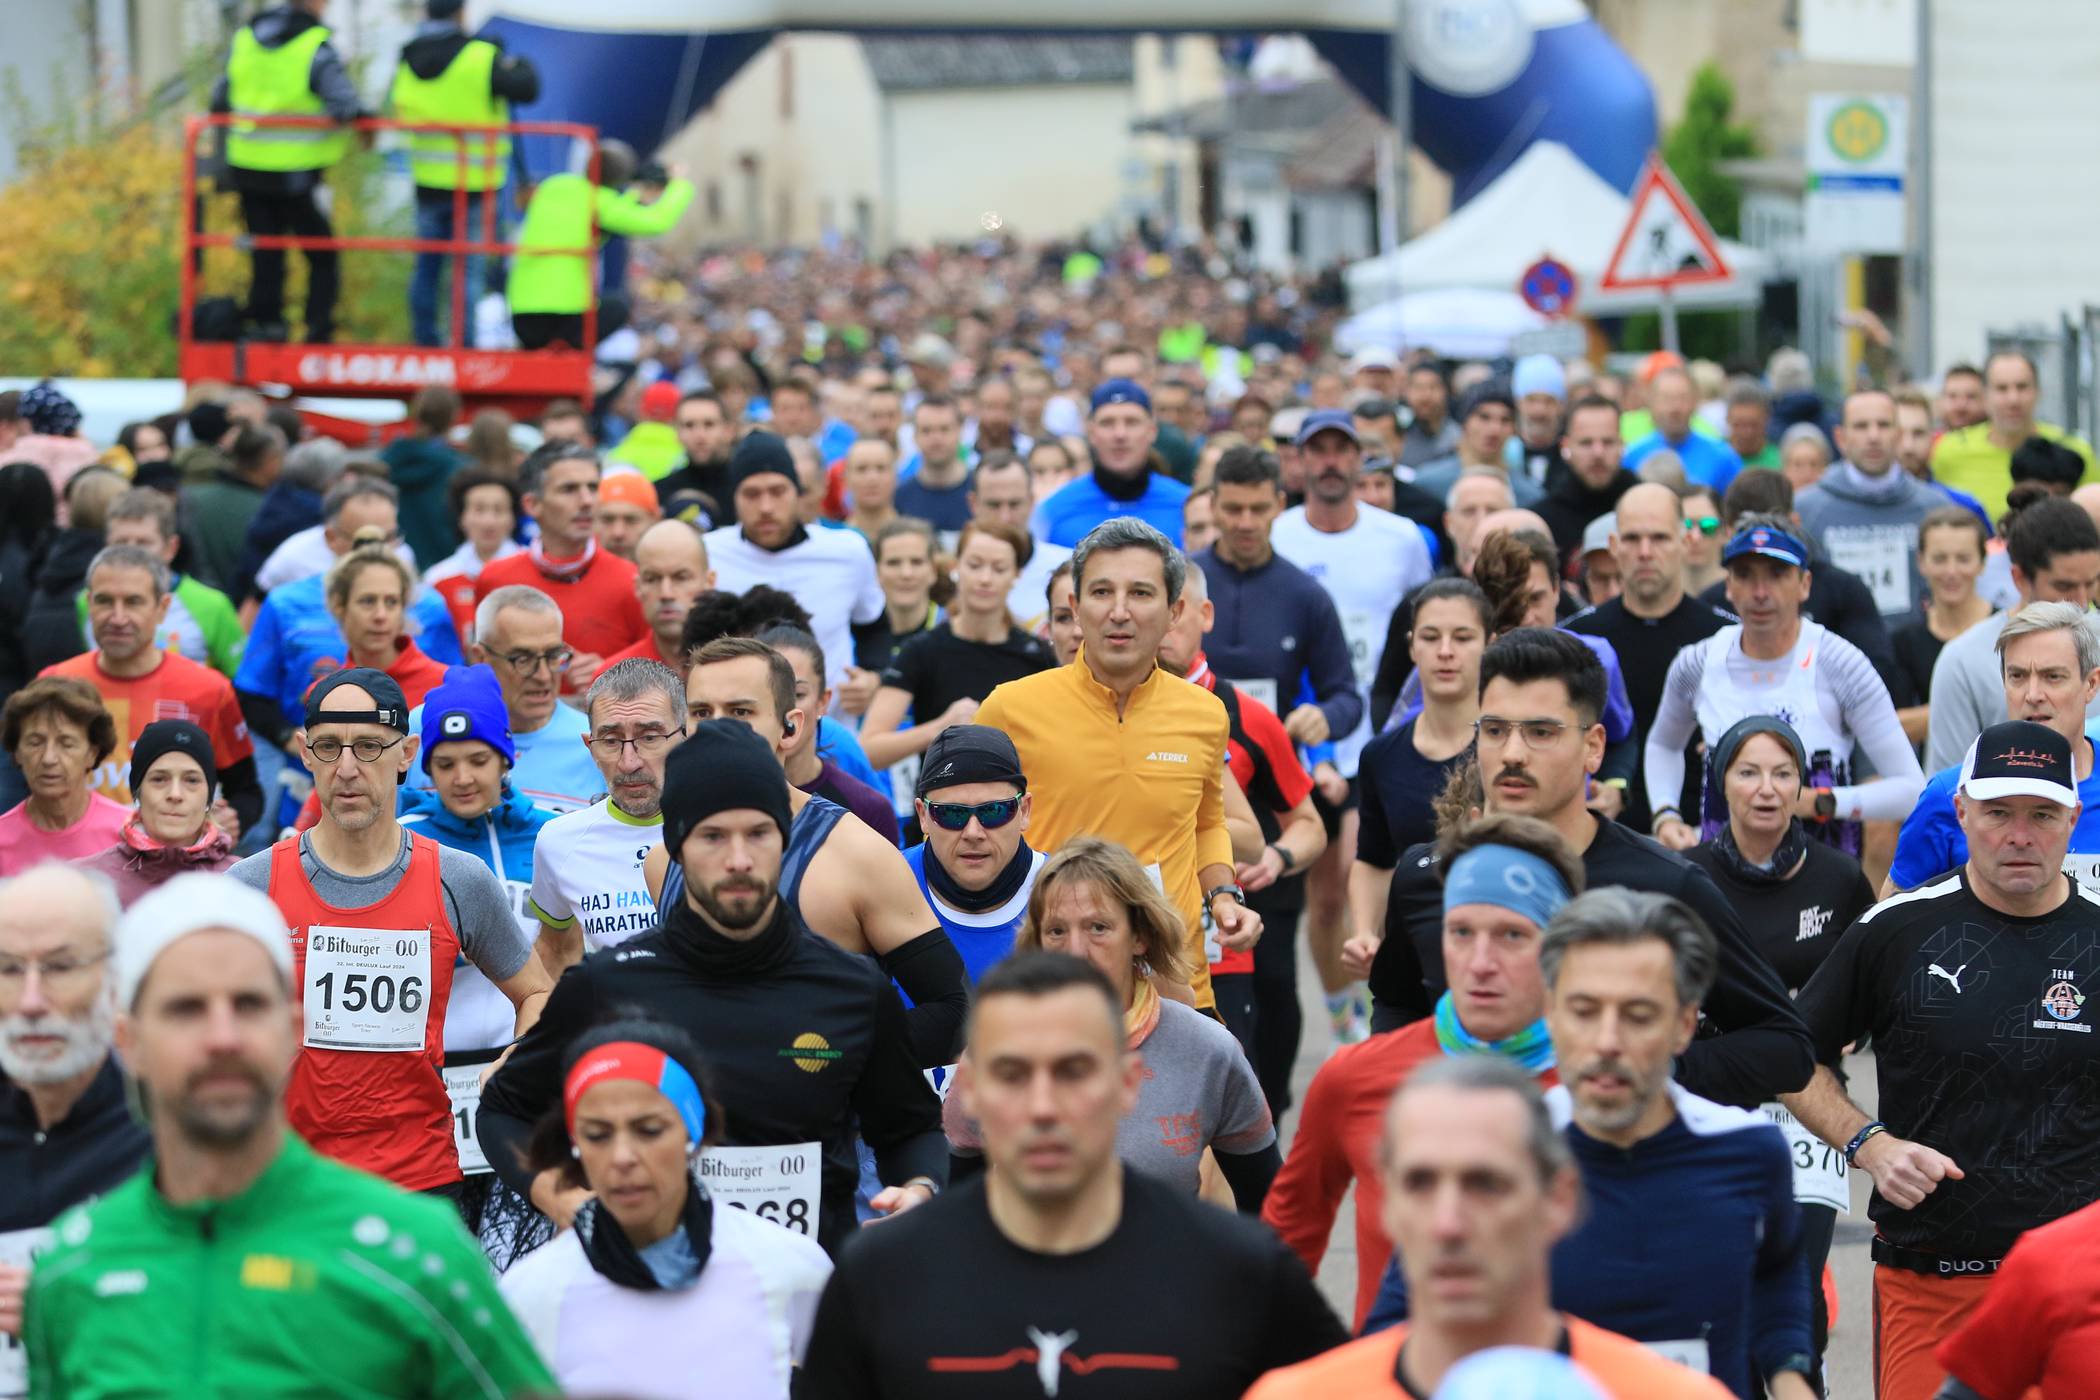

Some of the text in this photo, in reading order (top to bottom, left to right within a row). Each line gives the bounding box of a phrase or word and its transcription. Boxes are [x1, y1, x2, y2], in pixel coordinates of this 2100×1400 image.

[1159, 751, 1188, 764] TERREX
[581, 893, 610, 912] HAJ
[326, 935, 381, 957] Bitburger
[2052, 968, 2074, 980] TEAM
[315, 971, 423, 1014] 1506
[1792, 1140, 1845, 1176] 370
[700, 1157, 764, 1180] Bitburger
[1939, 1260, 1985, 1273] DUO
